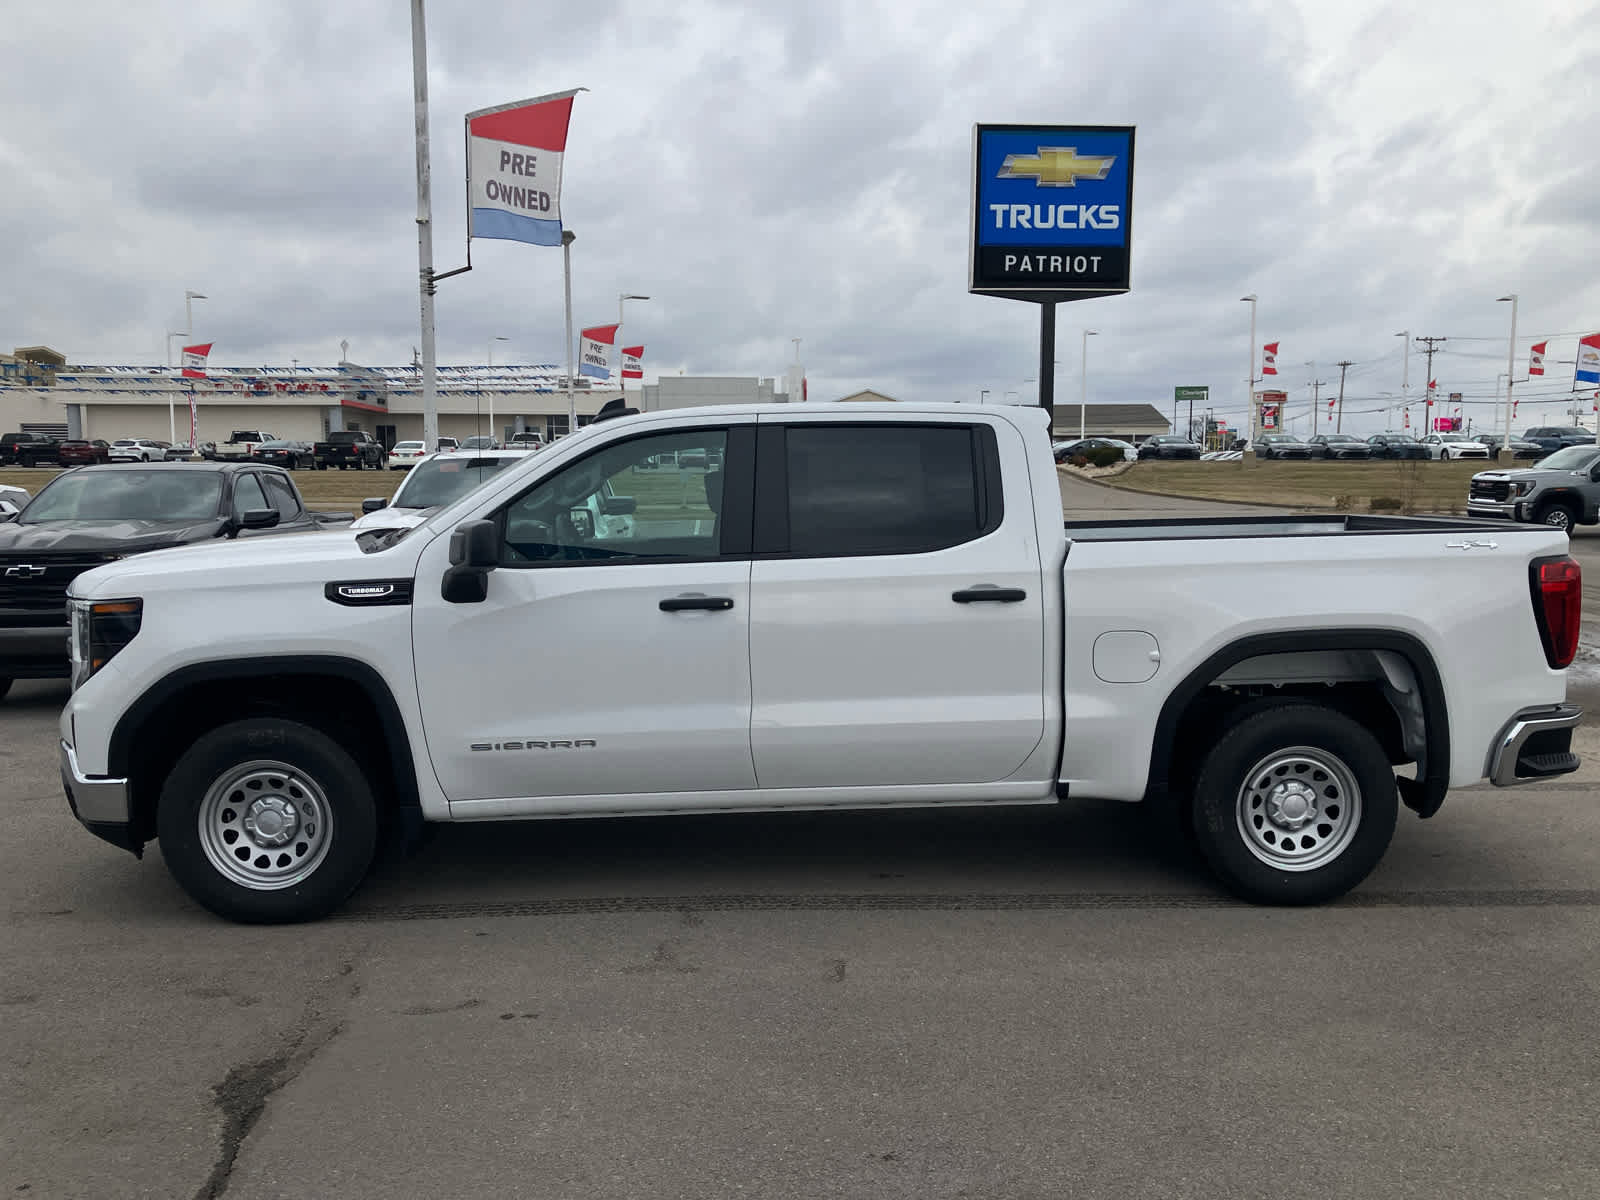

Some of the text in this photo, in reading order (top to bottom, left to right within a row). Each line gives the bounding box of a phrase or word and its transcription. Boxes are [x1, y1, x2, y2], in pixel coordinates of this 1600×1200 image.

[500, 150, 537, 177] PRE
[486, 179, 551, 212] OWNED
[989, 204, 1120, 229] TRUCKS
[1004, 255, 1102, 273] PATRIOT
[590, 342, 604, 354] PRE
[584, 353, 607, 367] OWNED
[470, 739, 597, 751] SIERRA
